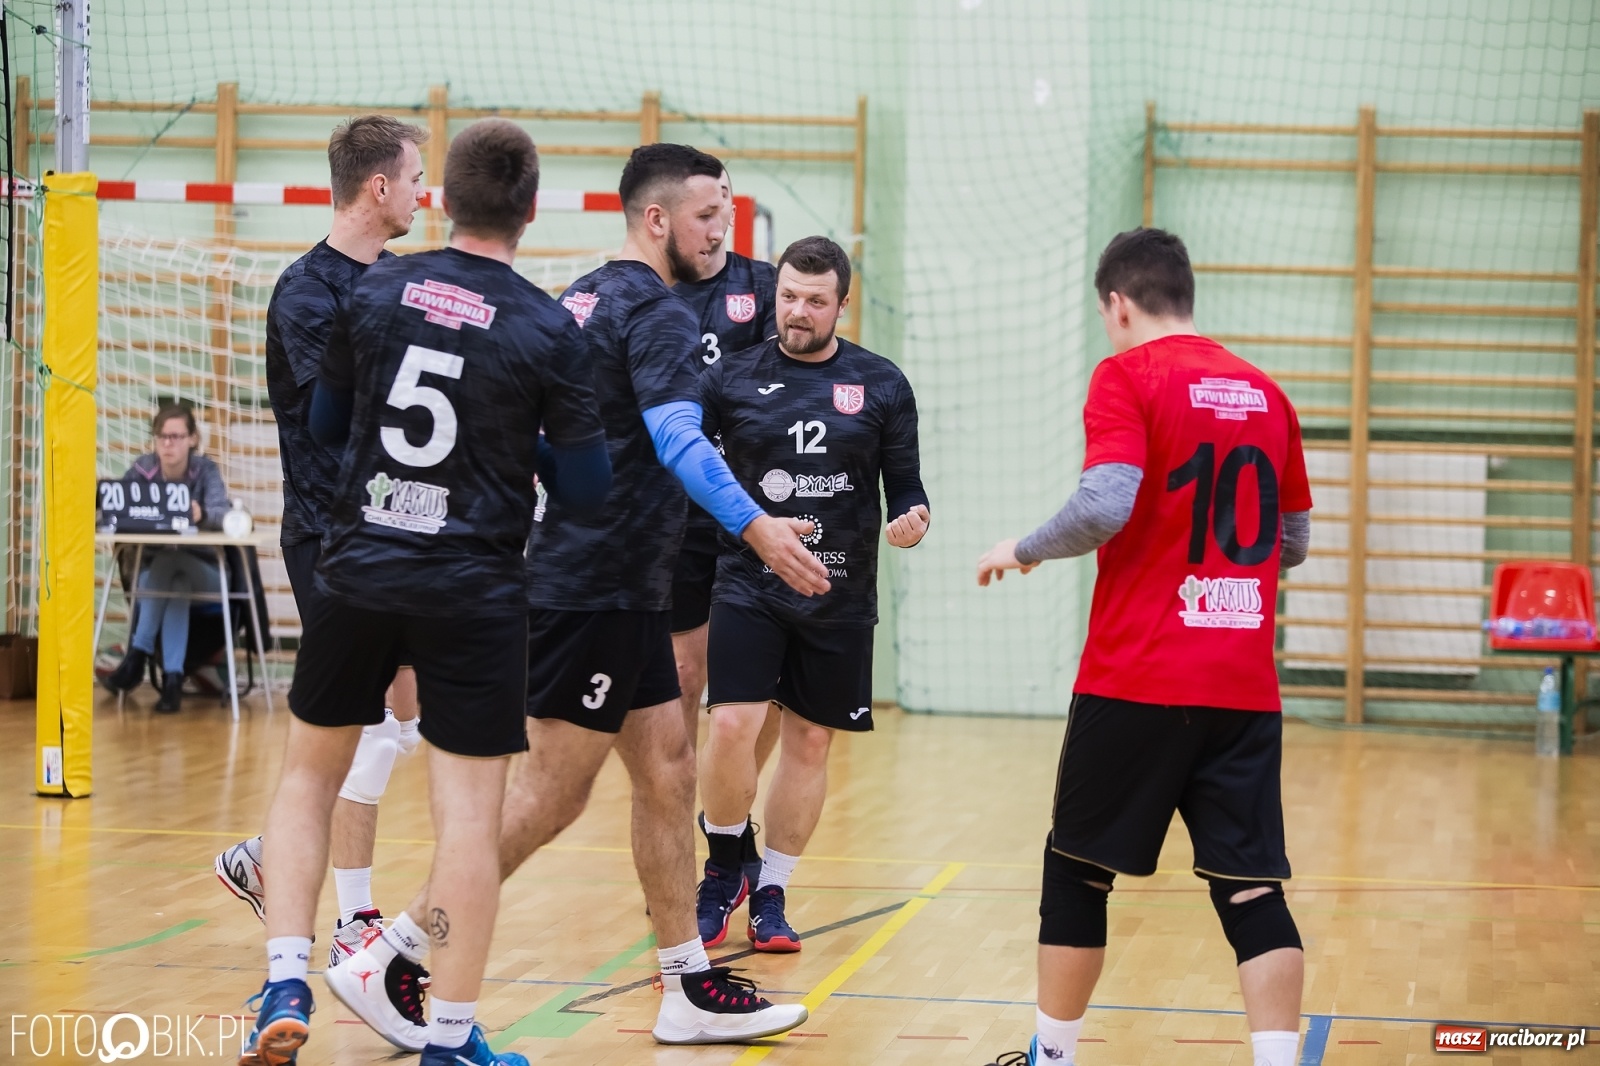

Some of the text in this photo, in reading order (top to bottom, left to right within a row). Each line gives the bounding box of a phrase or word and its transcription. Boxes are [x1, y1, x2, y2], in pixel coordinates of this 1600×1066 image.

[409, 288, 486, 322] PIWIARNIA
[380, 344, 464, 467] 5
[1194, 389, 1263, 406] PIWIARNIA
[788, 420, 827, 454] 12
[101, 481, 190, 512] 20 0 0 20
[391, 479, 449, 519] KAKTUS
[797, 472, 854, 492] DYMEL
[1166, 442, 1279, 566] 10
[1203, 579, 1260, 612] KAKTUS
[582, 672, 612, 709] 3
